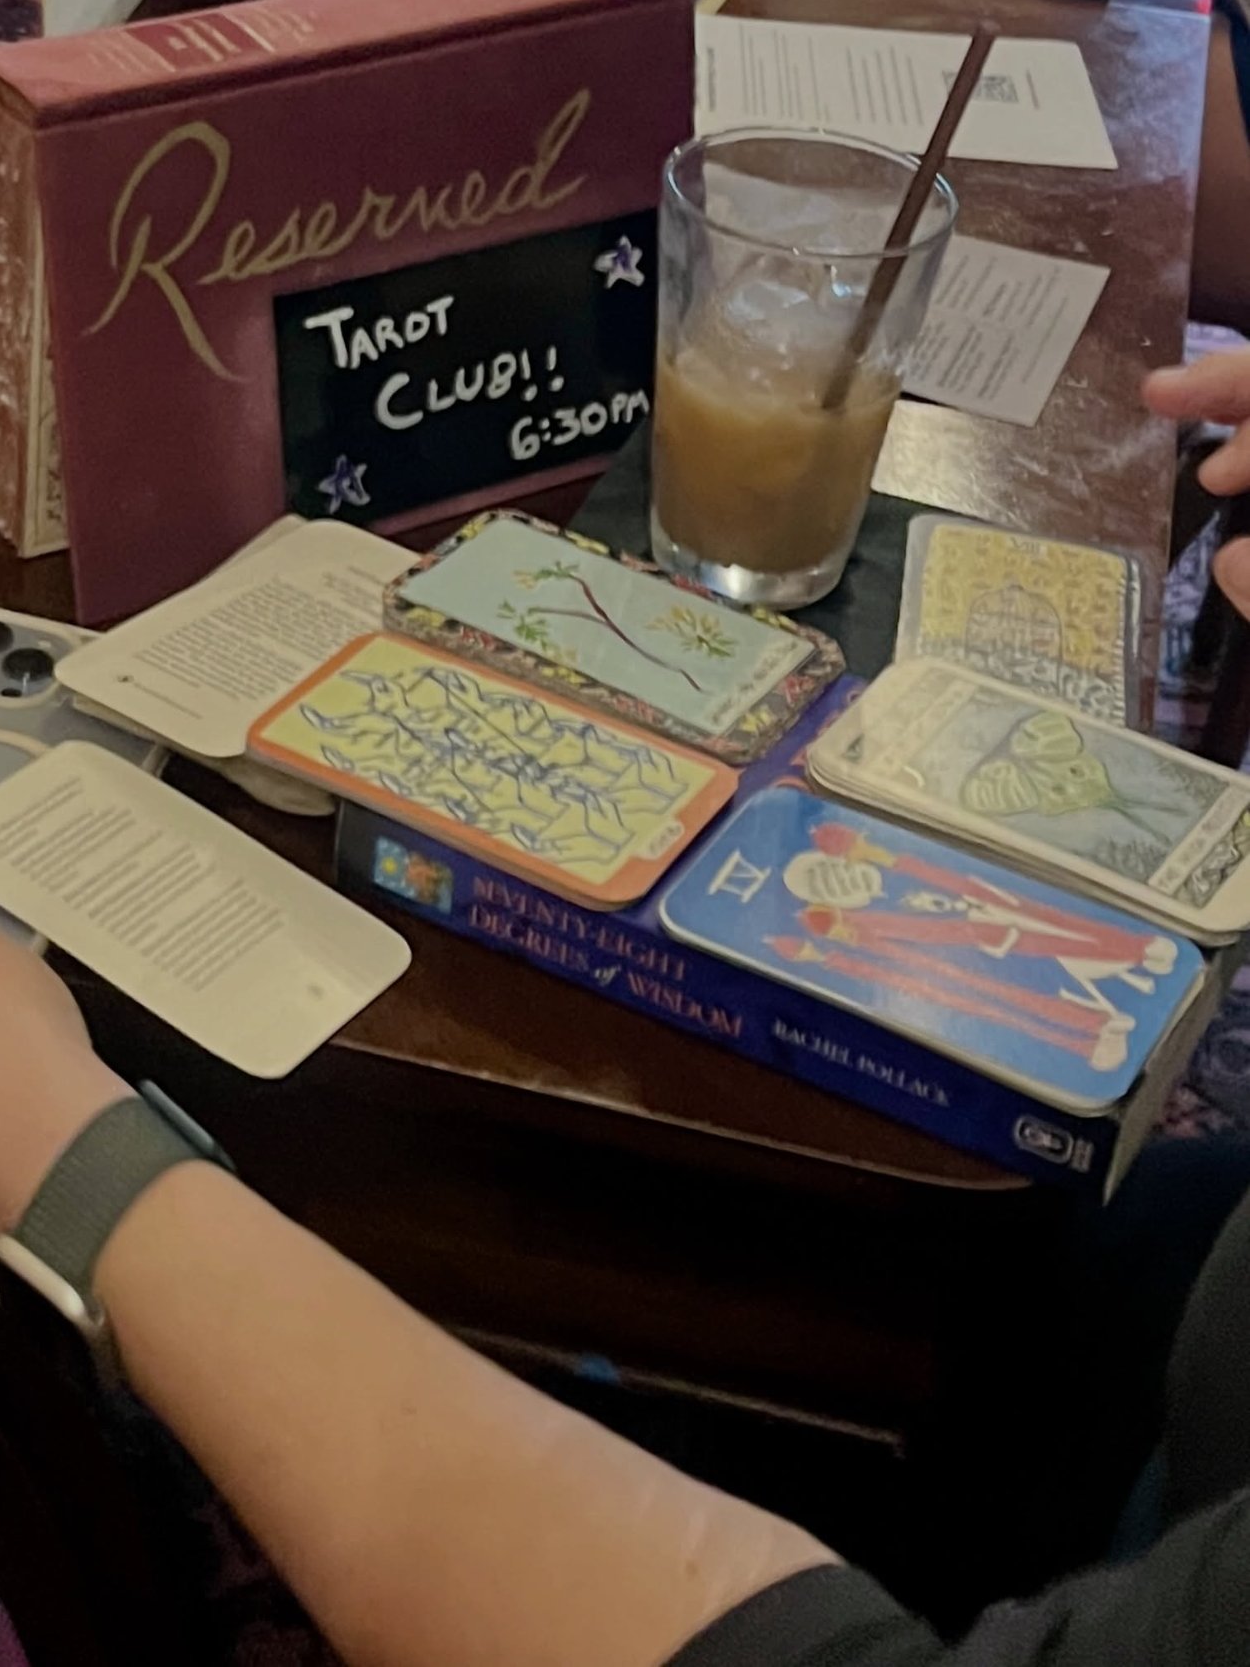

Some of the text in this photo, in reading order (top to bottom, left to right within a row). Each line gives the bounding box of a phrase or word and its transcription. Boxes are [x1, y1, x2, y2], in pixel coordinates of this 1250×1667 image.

[79, 89, 592, 382] Reserved
[304, 296, 454, 370] TAROT
[376, 346, 565, 431] CLUB!!
[468, 901, 743, 1038] DEGREES of WISDOM
[773, 1017, 950, 1108] RACHEL POLLACK
